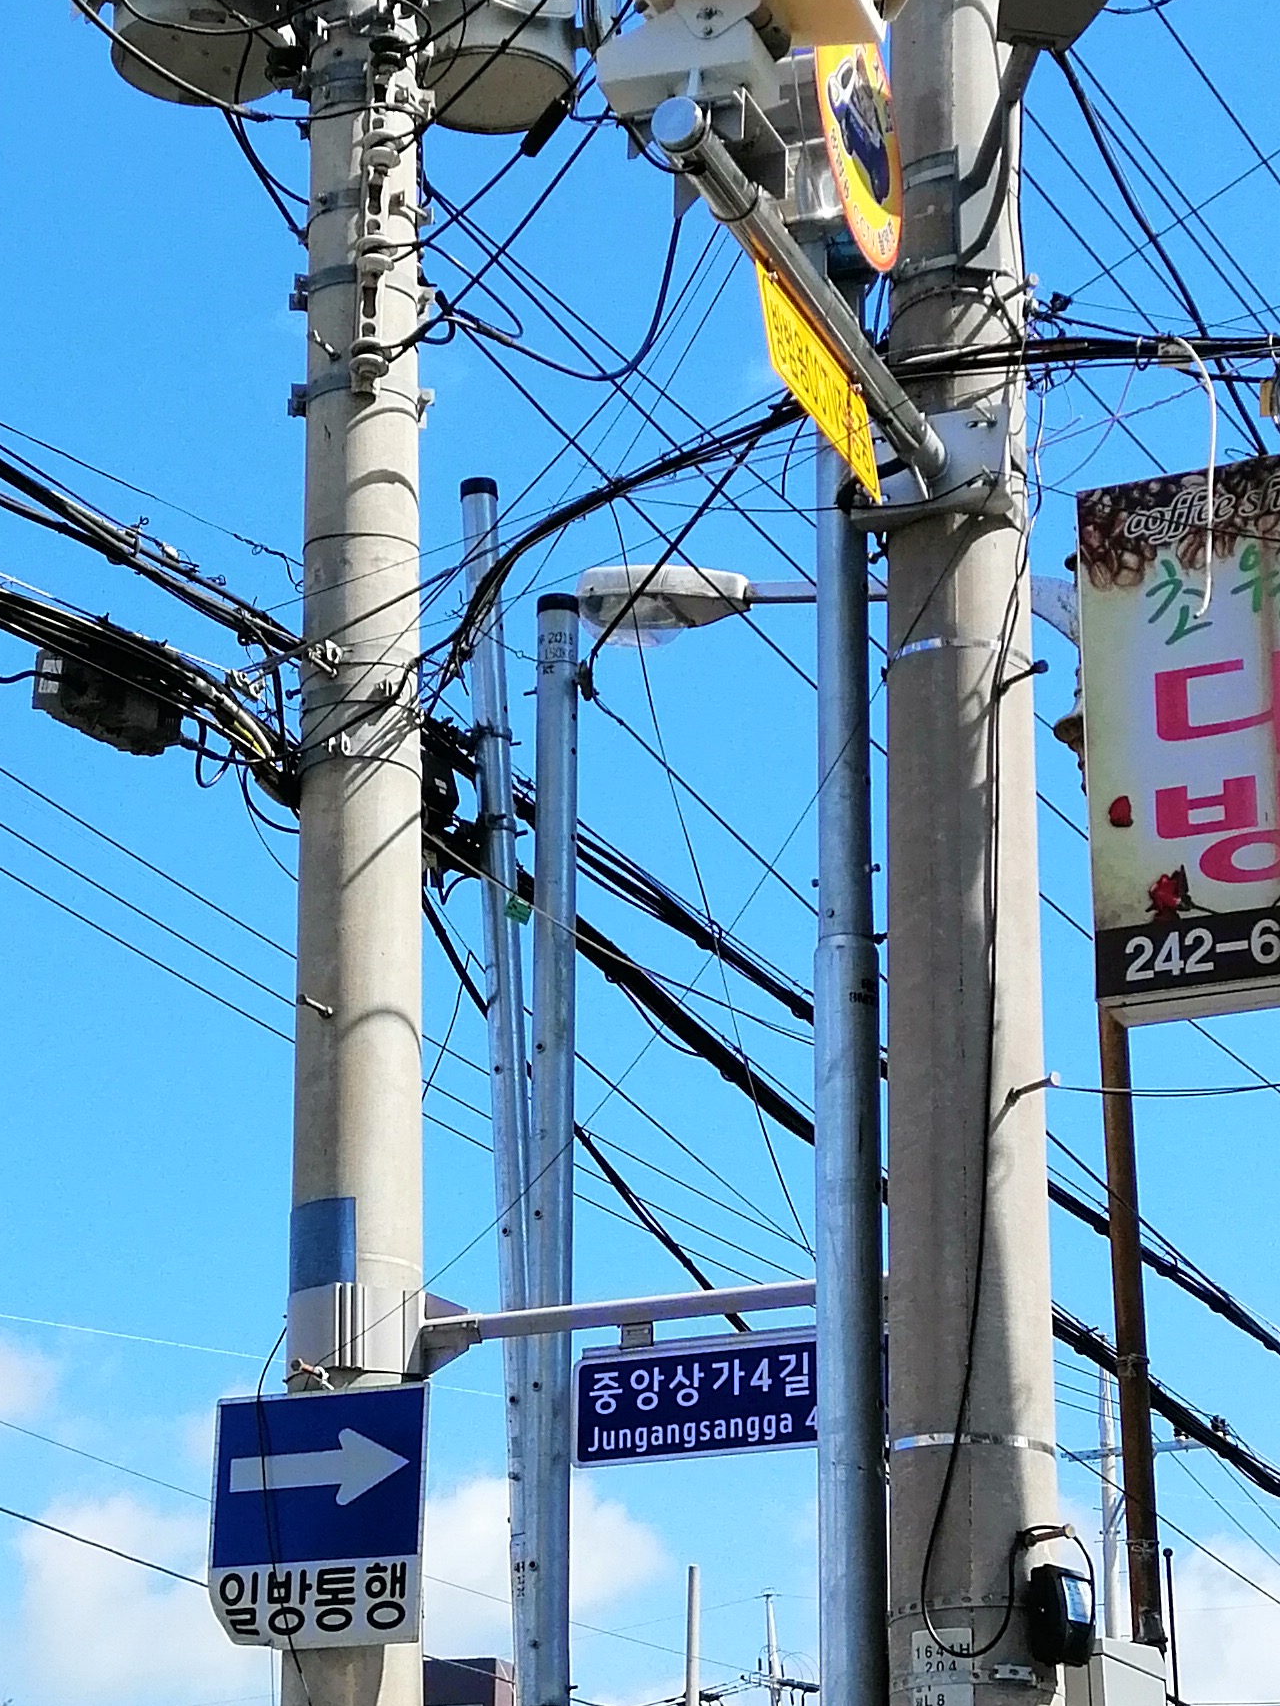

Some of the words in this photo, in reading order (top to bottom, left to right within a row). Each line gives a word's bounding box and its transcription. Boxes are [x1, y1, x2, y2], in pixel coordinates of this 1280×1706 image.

[1125, 486, 1232, 546] coffee
[588, 1349, 811, 1416] 중앙상가4길
[587, 1415, 795, 1453] Jungangsangga
[219, 1560, 410, 1638] 일방통행
[925, 1659, 958, 1673] 204
